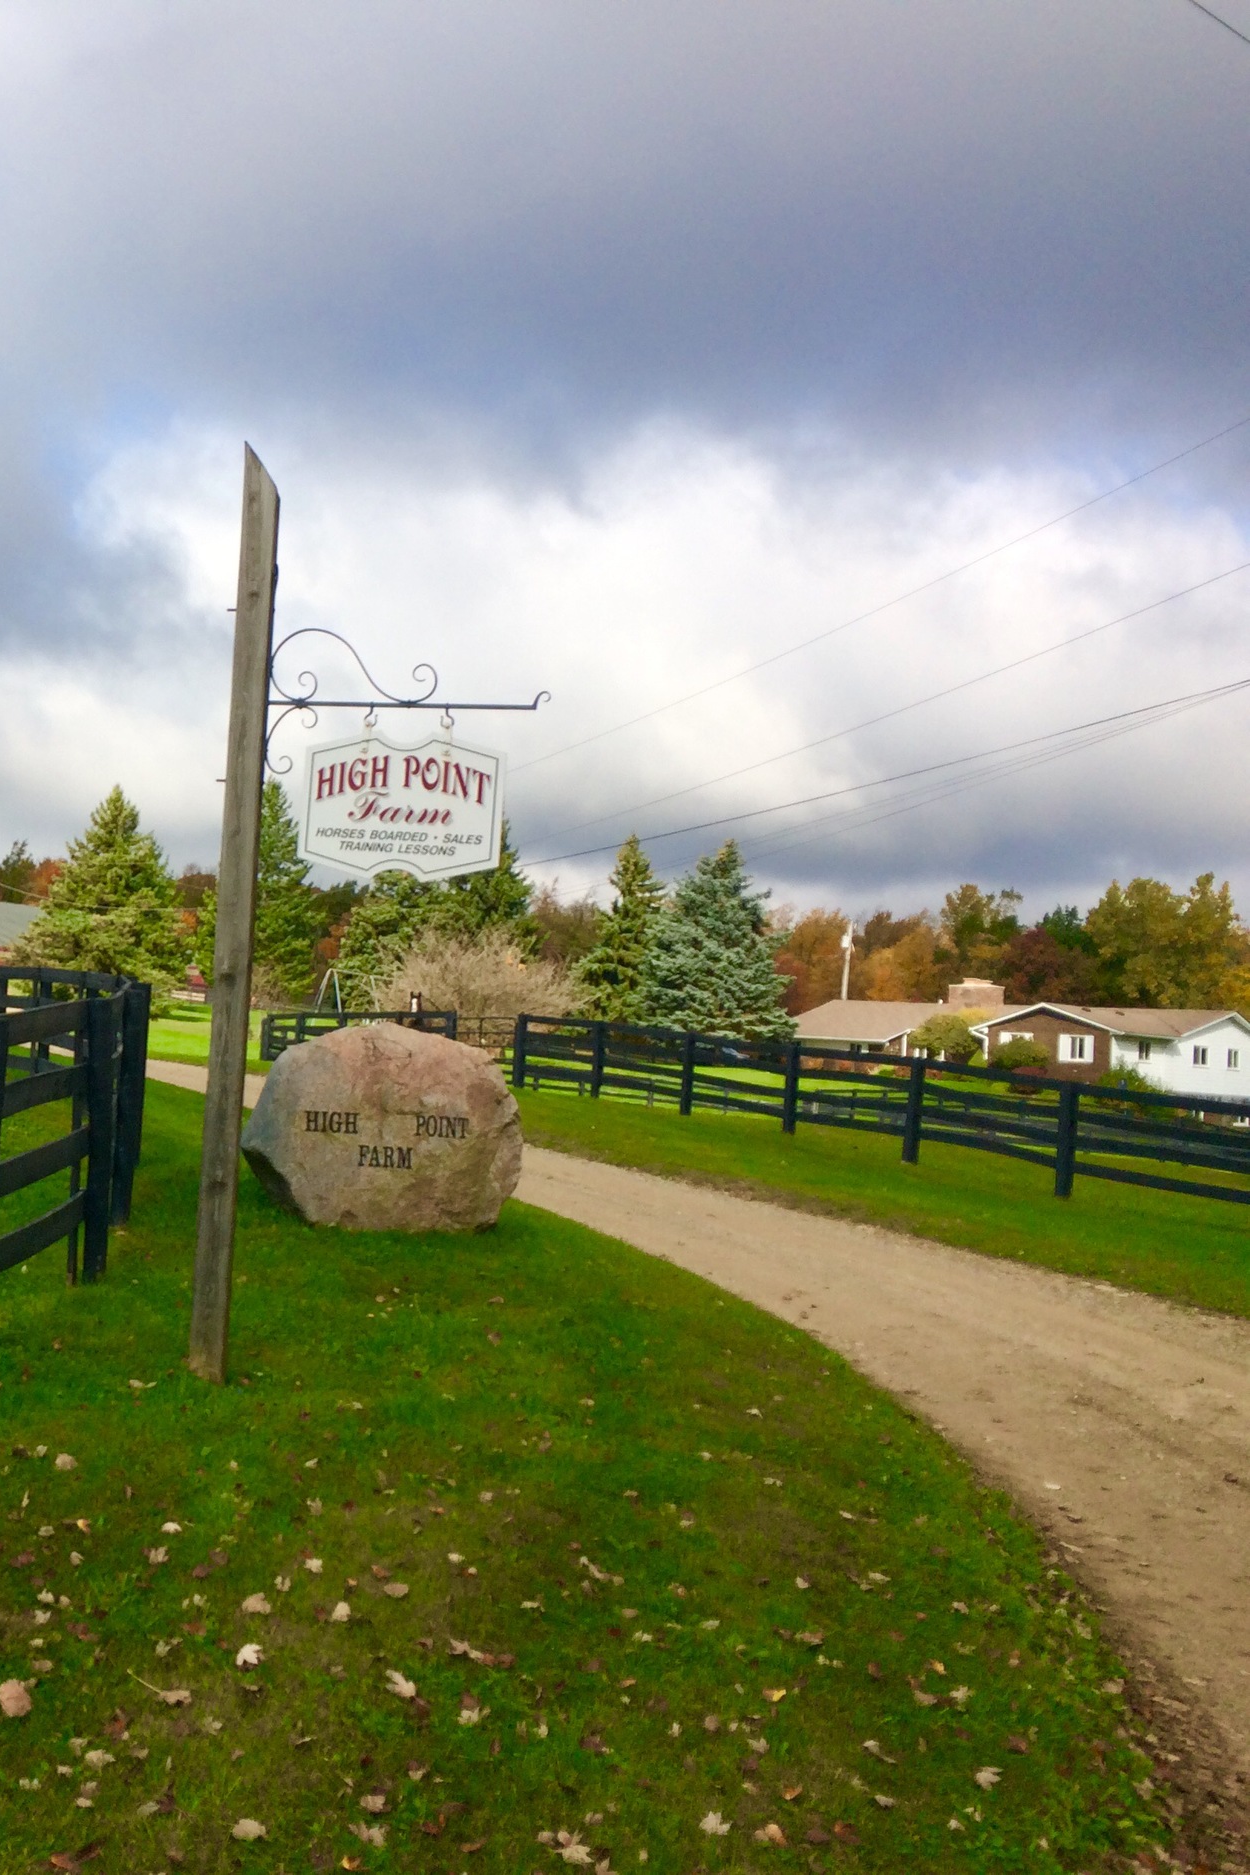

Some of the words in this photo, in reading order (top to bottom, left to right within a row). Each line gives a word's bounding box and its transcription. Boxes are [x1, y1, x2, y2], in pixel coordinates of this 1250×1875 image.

[315, 754, 390, 801] HIGH
[402, 755, 491, 805] POINT
[347, 791, 454, 825] Farm
[315, 827, 365, 839] HORSES
[369, 829, 428, 842] BOARDED
[442, 833, 483, 846] SALES
[339, 840, 394, 854] TRAINING
[398, 843, 456, 857] LESSONS
[304, 1110, 360, 1135] HIGH
[415, 1115, 469, 1139] POINT
[357, 1144, 413, 1170] FARM
